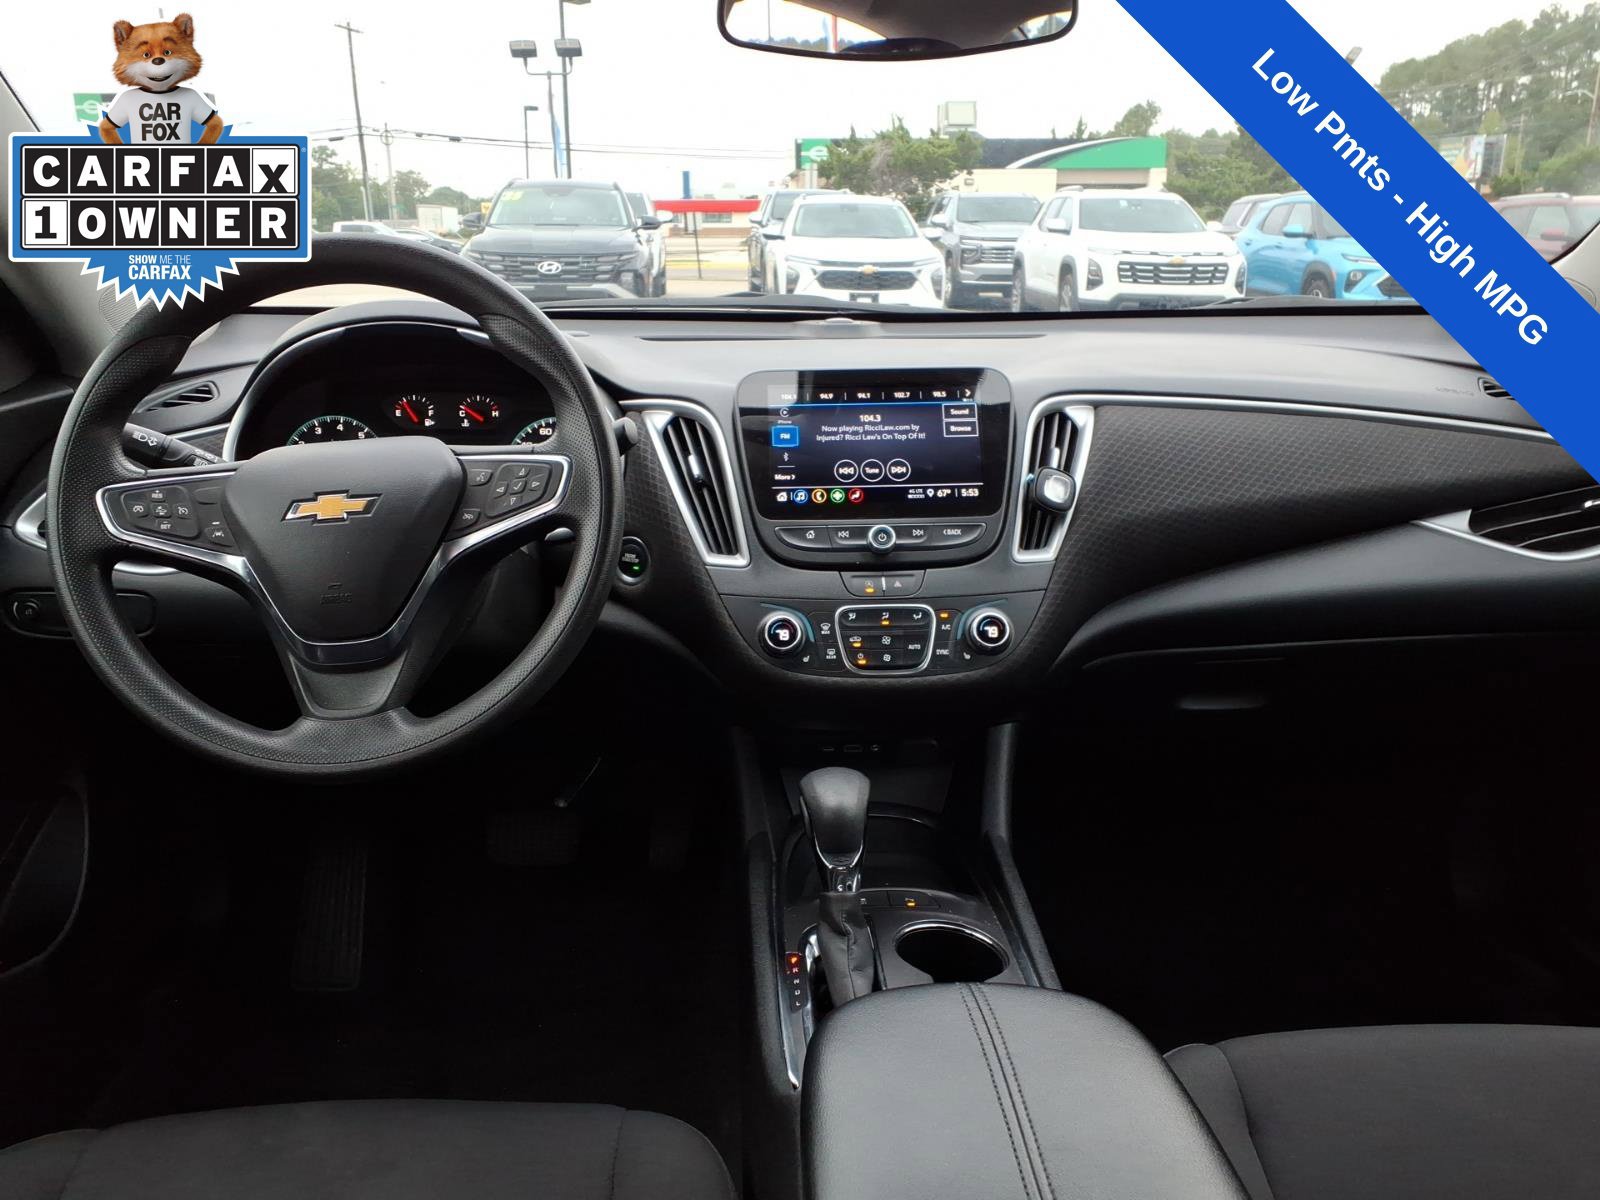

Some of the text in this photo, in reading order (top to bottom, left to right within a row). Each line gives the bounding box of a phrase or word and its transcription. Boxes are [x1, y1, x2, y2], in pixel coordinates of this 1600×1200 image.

[859, 414, 882, 422] 104.3
[838, 425, 864, 433] playing
[911, 423, 920, 431] by
[357, 431, 365, 439] 5
[816, 434, 844, 442] Injured?
[893, 433, 907, 441] Top
[961, 488, 979, 497] 5:53
[947, 528, 962, 536] BACK
